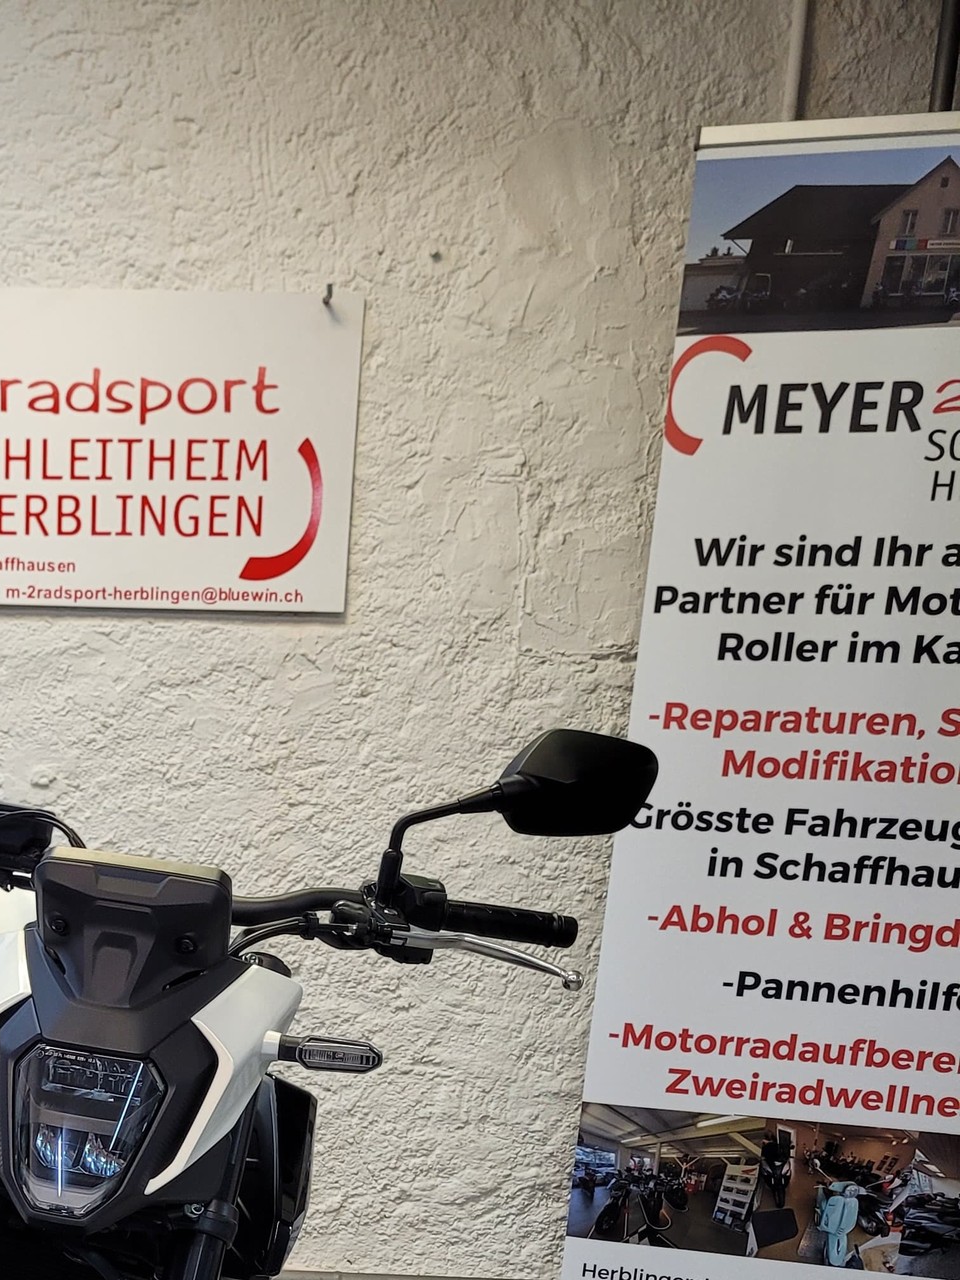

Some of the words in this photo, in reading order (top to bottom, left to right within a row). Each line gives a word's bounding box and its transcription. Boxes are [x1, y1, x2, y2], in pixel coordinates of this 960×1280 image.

[722, 381, 924, 435] MEYER
[694, 534, 765, 567] Wir
[773, 534, 862, 567] sind
[873, 535, 933, 567] Ihr
[6, 585, 303, 604] m-2radsport-herblingen@bluewin.ch
[653, 585, 805, 615] Partner
[814, 583, 874, 615] für
[717, 632, 837, 662] Roller
[847, 631, 900, 663] im
[648, 702, 925, 740] -Reparaturen,
[721, 749, 960, 785] Modifikatio
[707, 847, 743, 878] in
[647, 904, 778, 937] -Abhol
[788, 911, 812, 940] &
[722, 971, 960, 1012] -Pannenhilf
